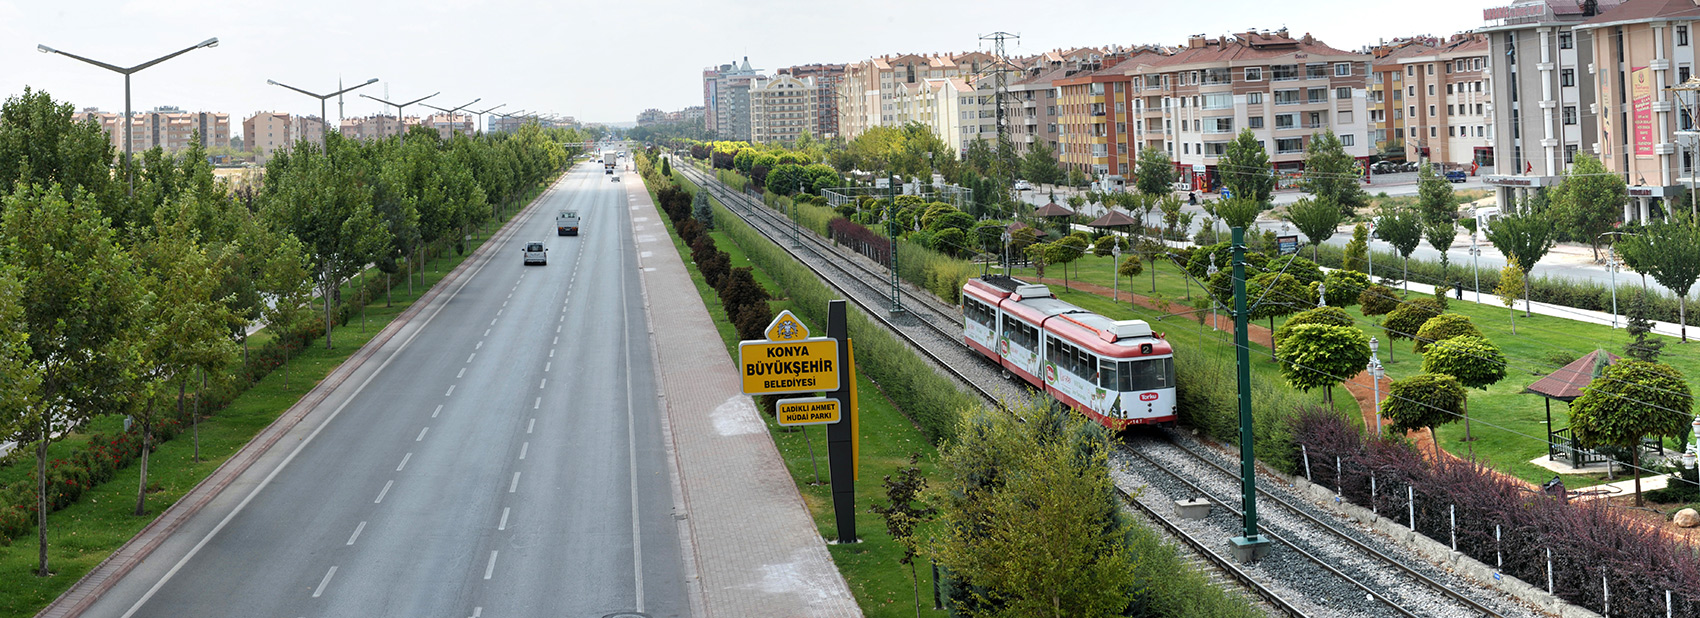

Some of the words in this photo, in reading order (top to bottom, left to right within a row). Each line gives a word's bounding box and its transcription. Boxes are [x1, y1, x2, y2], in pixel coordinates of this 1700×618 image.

[767, 346, 809, 358] KONYA
[1143, 346, 1150, 354] 2
[746, 358, 832, 377] BÜYÜKŞEHİR
[764, 376, 816, 388] BELEDİYESİ
